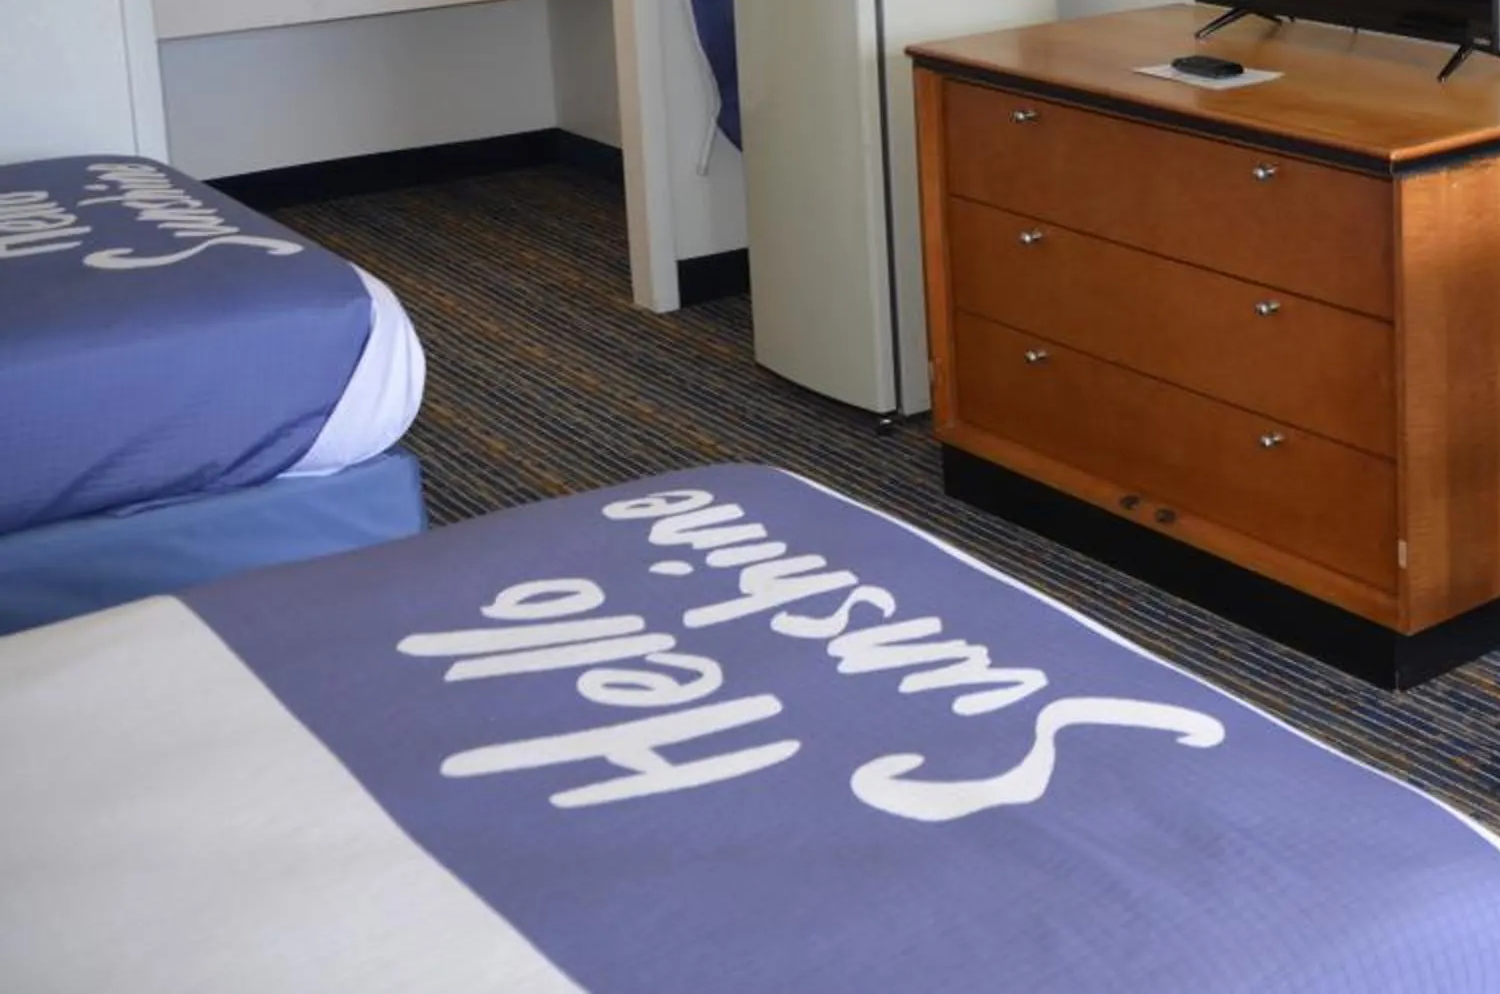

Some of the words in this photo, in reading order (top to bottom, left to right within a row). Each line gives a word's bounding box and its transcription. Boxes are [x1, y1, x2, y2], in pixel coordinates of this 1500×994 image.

[78, 163, 304, 269] Sunshine
[397, 578, 801, 809] Hello
[602, 490, 1225, 822] Sunshine
